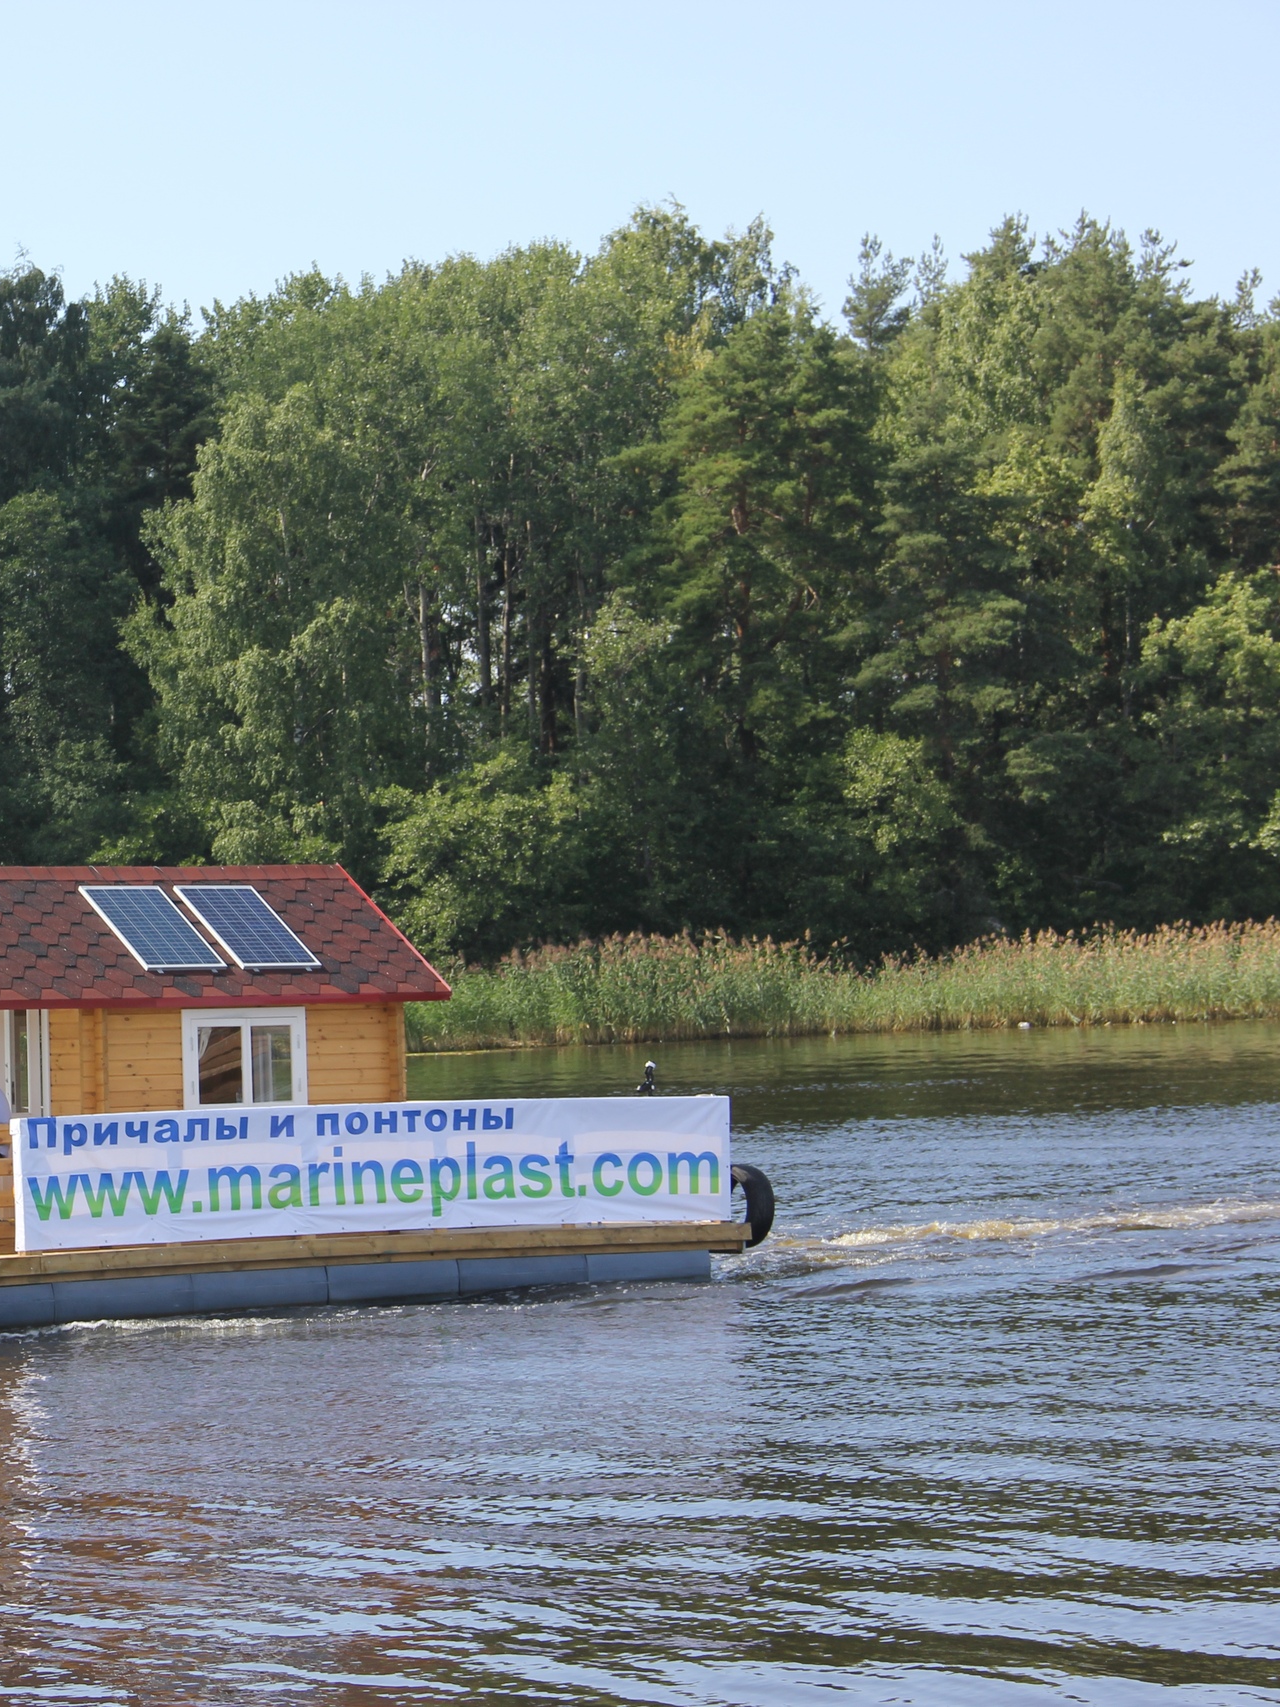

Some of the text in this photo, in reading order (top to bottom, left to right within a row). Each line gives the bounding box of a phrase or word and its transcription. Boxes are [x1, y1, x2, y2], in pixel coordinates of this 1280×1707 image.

[27, 1107, 515, 1156] Причалы и понтоны
[26, 1140, 720, 1222] www.marineplast.com
